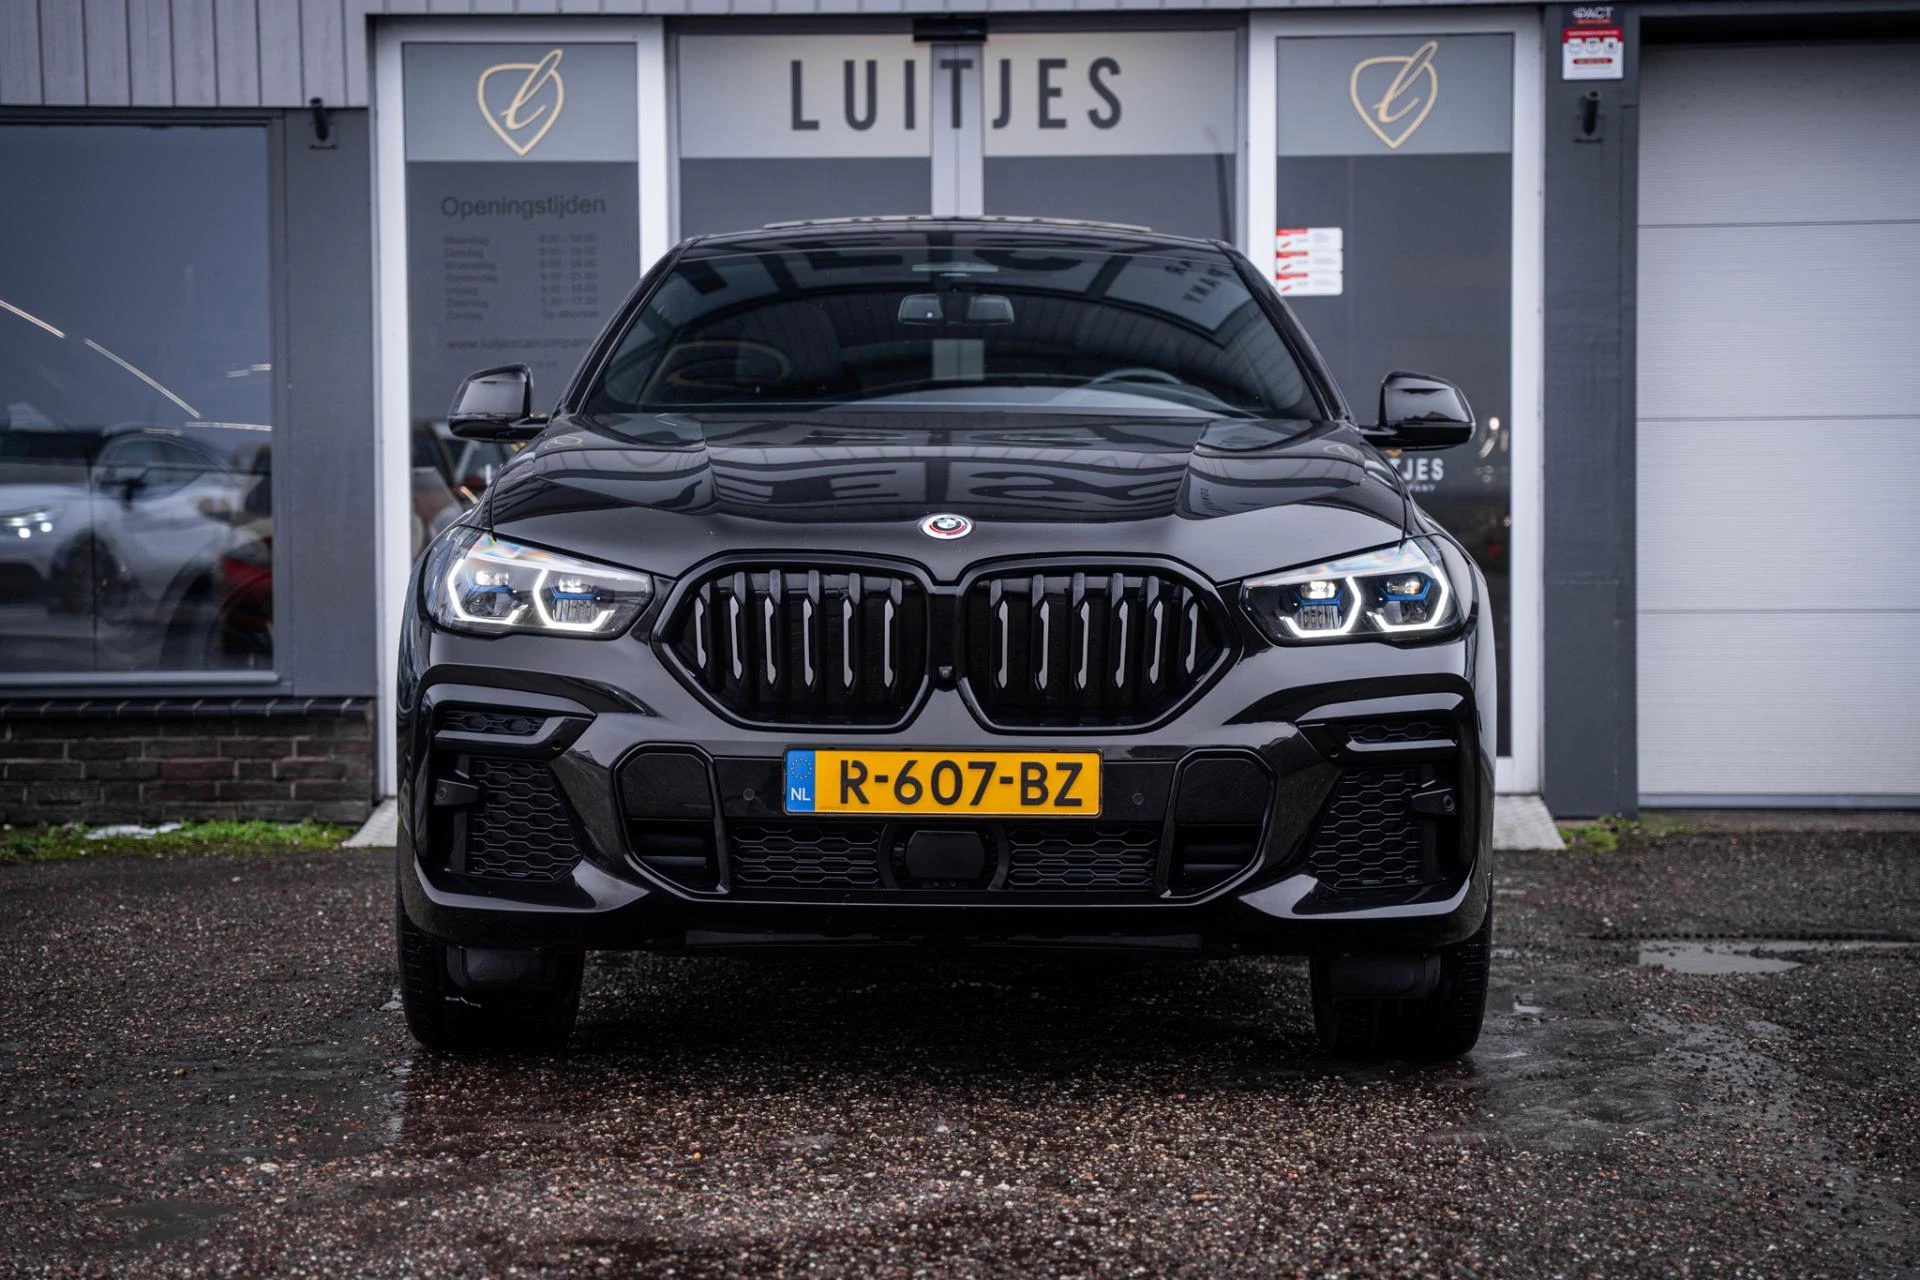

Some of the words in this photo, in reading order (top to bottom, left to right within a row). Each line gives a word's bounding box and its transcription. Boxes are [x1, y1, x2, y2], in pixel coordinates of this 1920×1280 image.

[790, 57, 1122, 131] LUITJES
[440, 196, 606, 220] Openingstijden
[790, 787, 811, 801] NL
[840, 759, 1083, 807] R-607-BZ
